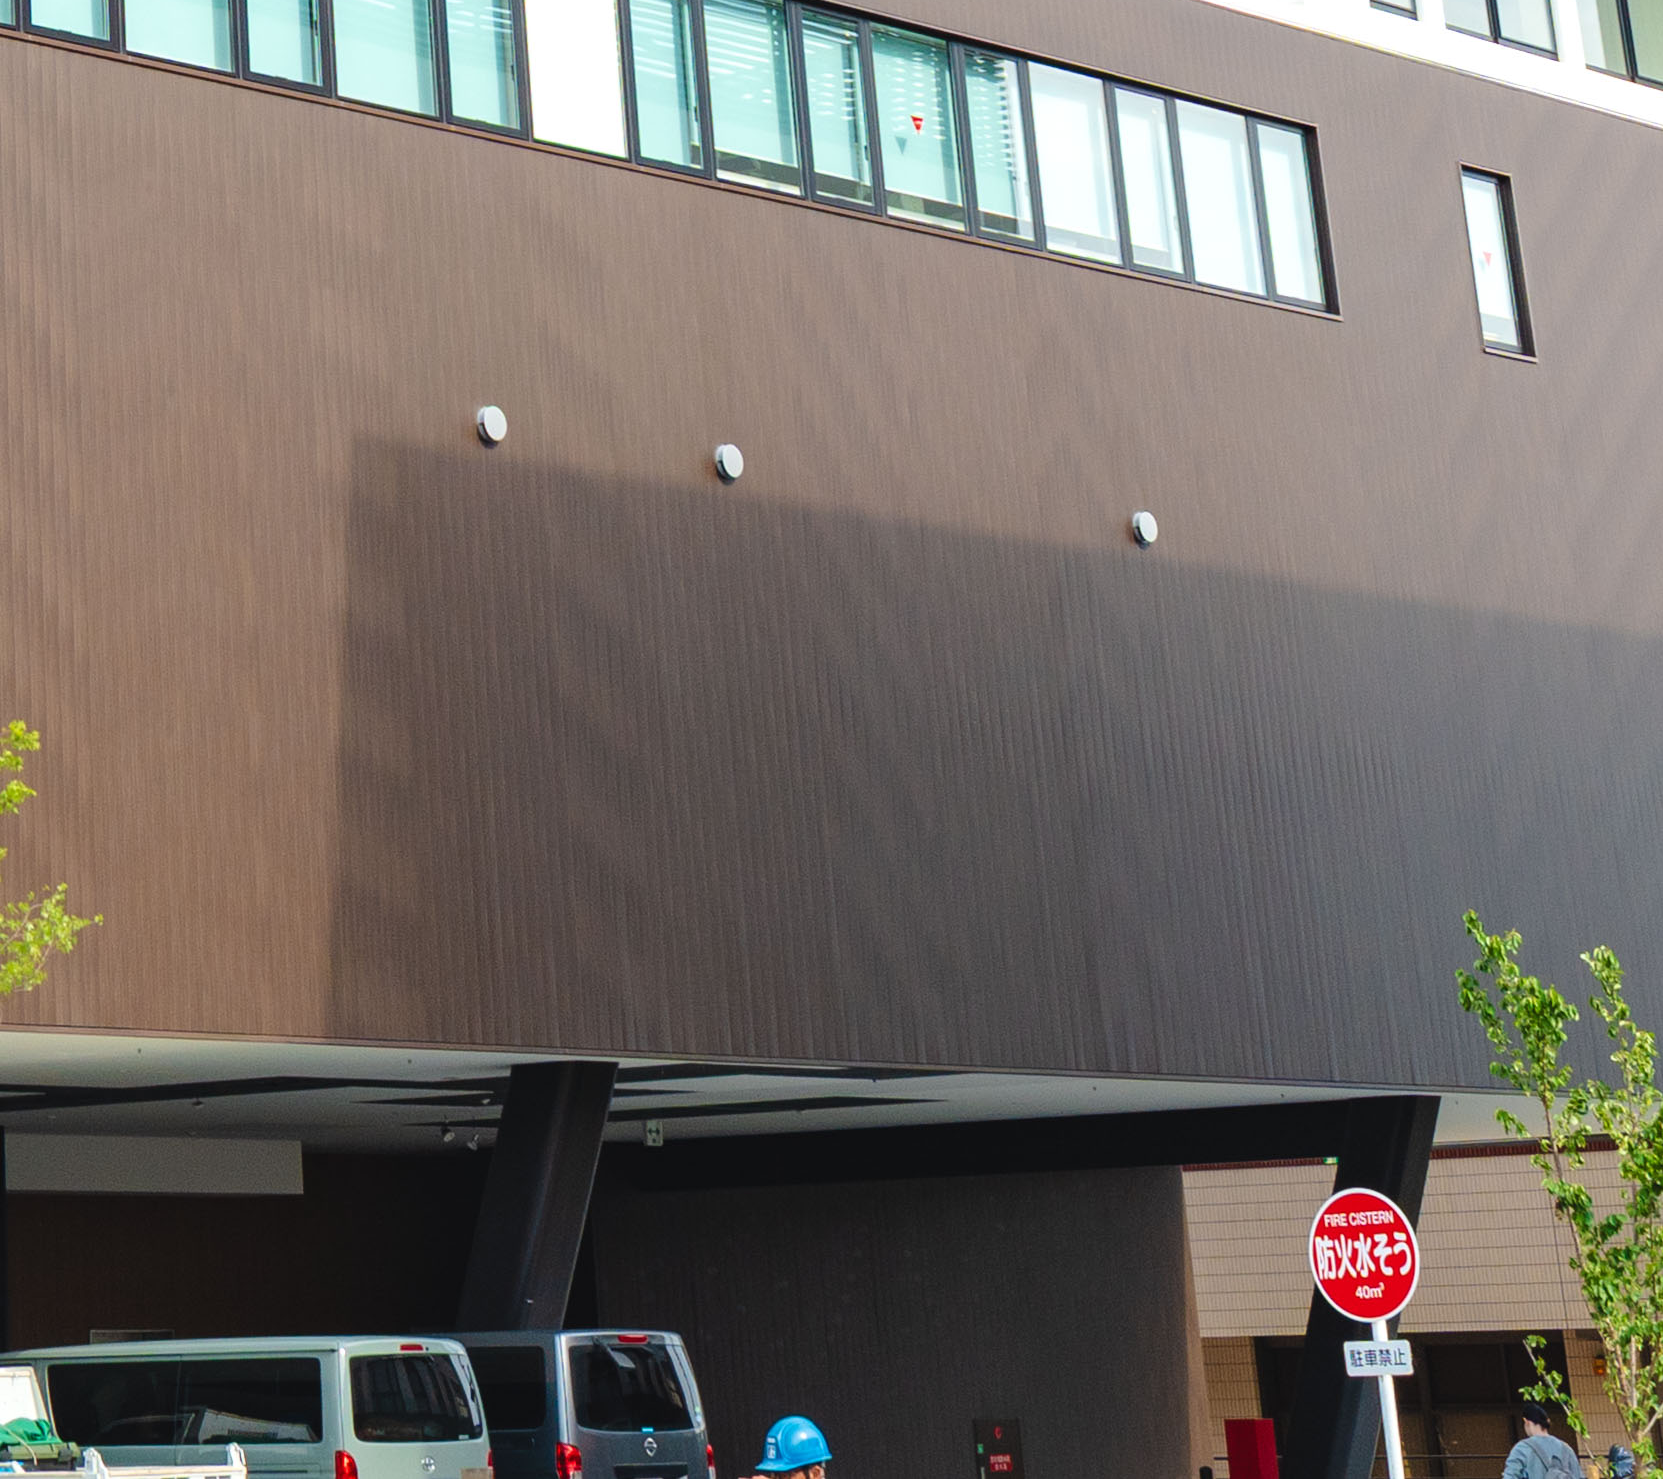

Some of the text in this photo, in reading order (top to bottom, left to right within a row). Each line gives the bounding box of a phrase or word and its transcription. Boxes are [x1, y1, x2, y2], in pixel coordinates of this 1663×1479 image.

[1323, 1210, 1394, 1228] FIRE CISTERN
[1314, 1230, 1413, 1281] 防火水そう
[1349, 1348, 1407, 1368] 駐車禁止
